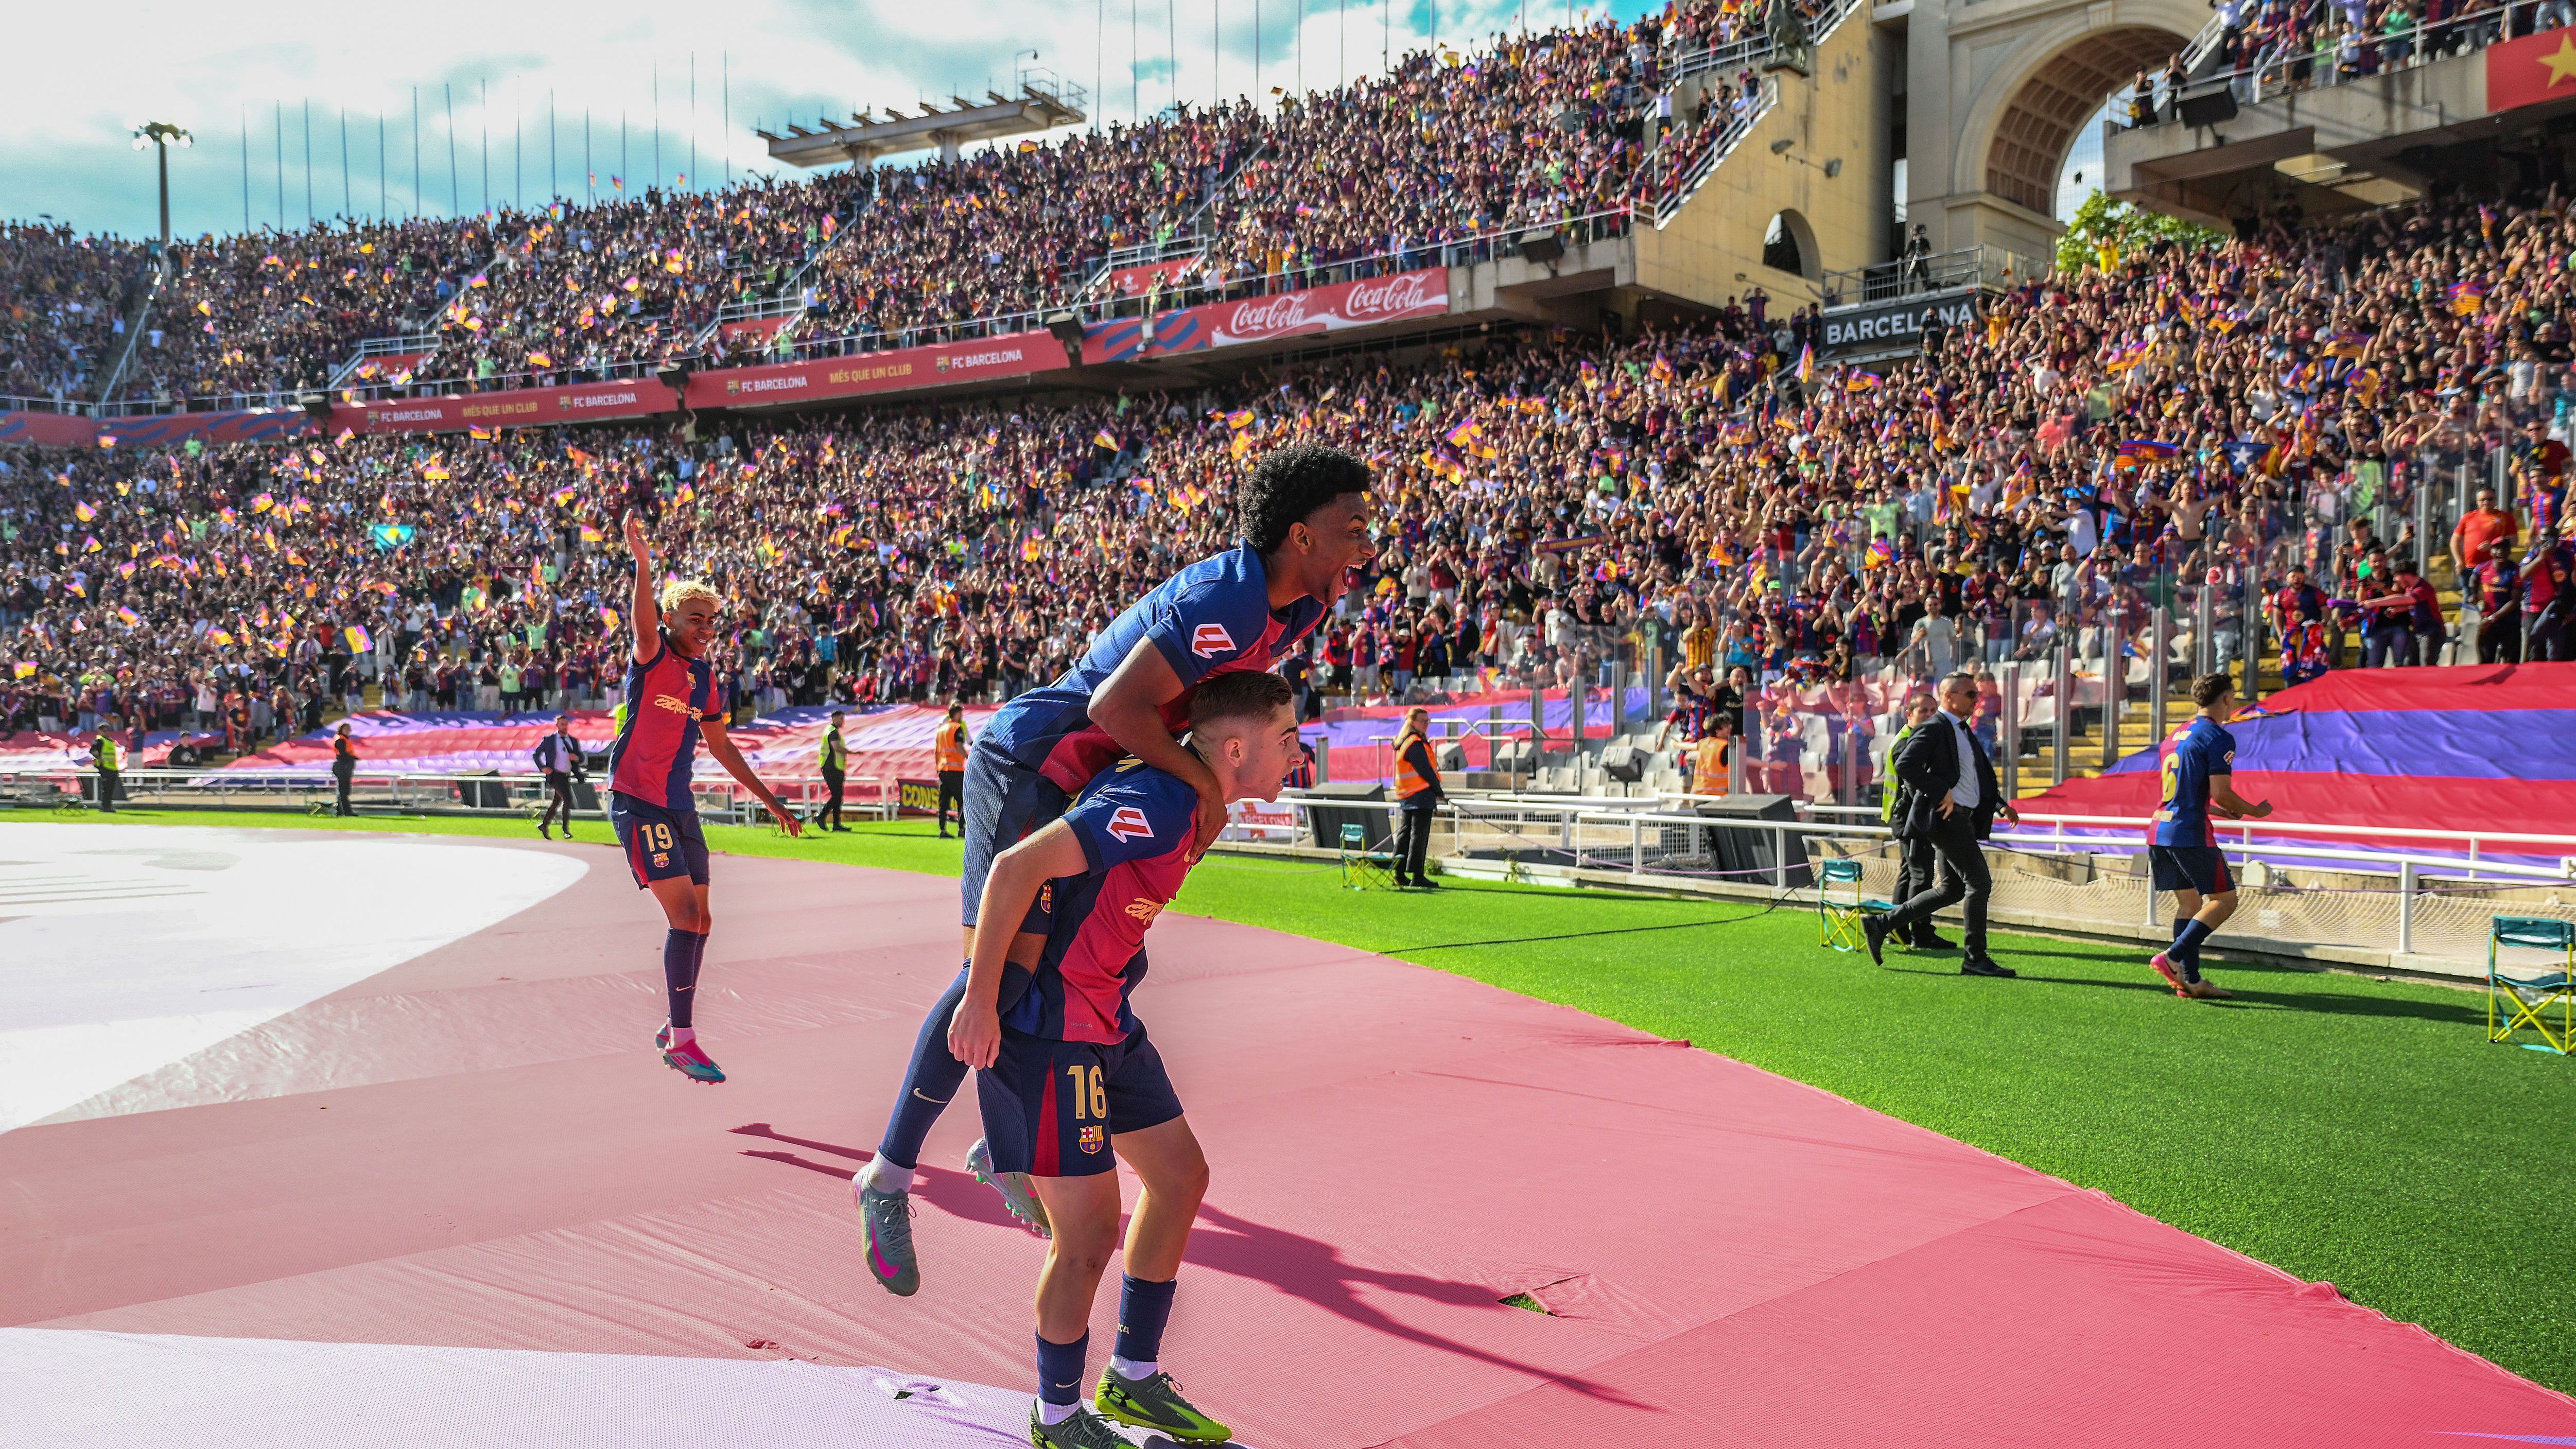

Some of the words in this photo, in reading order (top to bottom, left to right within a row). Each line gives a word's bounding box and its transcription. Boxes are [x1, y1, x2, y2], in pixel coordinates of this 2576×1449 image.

[1346, 272, 1432, 317] Coca-Cola
[1231, 292, 1311, 334] Coca-Cola
[952, 357, 964, 369] FC
[966, 350, 1023, 367] BARCELONA
[830, 370, 849, 383] MÉS
[851, 369, 871, 382] QUE
[873, 367, 886, 379] UN
[888, 364, 912, 377] CLUB
[742, 381, 753, 392] FC
[755, 376, 808, 391] BARCELONA
[482, 404, 500, 417] QUE
[502, 404, 514, 414] UN
[516, 401, 538, 413] CLUB
[573, 397, 585, 408] FC
[586, 393, 637, 407] BARCELONA
[381, 412, 392, 423] FC
[393, 408, 443, 422] BARCELONA
[2162, 753, 2180, 802] 6
[641, 823, 673, 852] 19
[1067, 1065, 1106, 1119] 16
